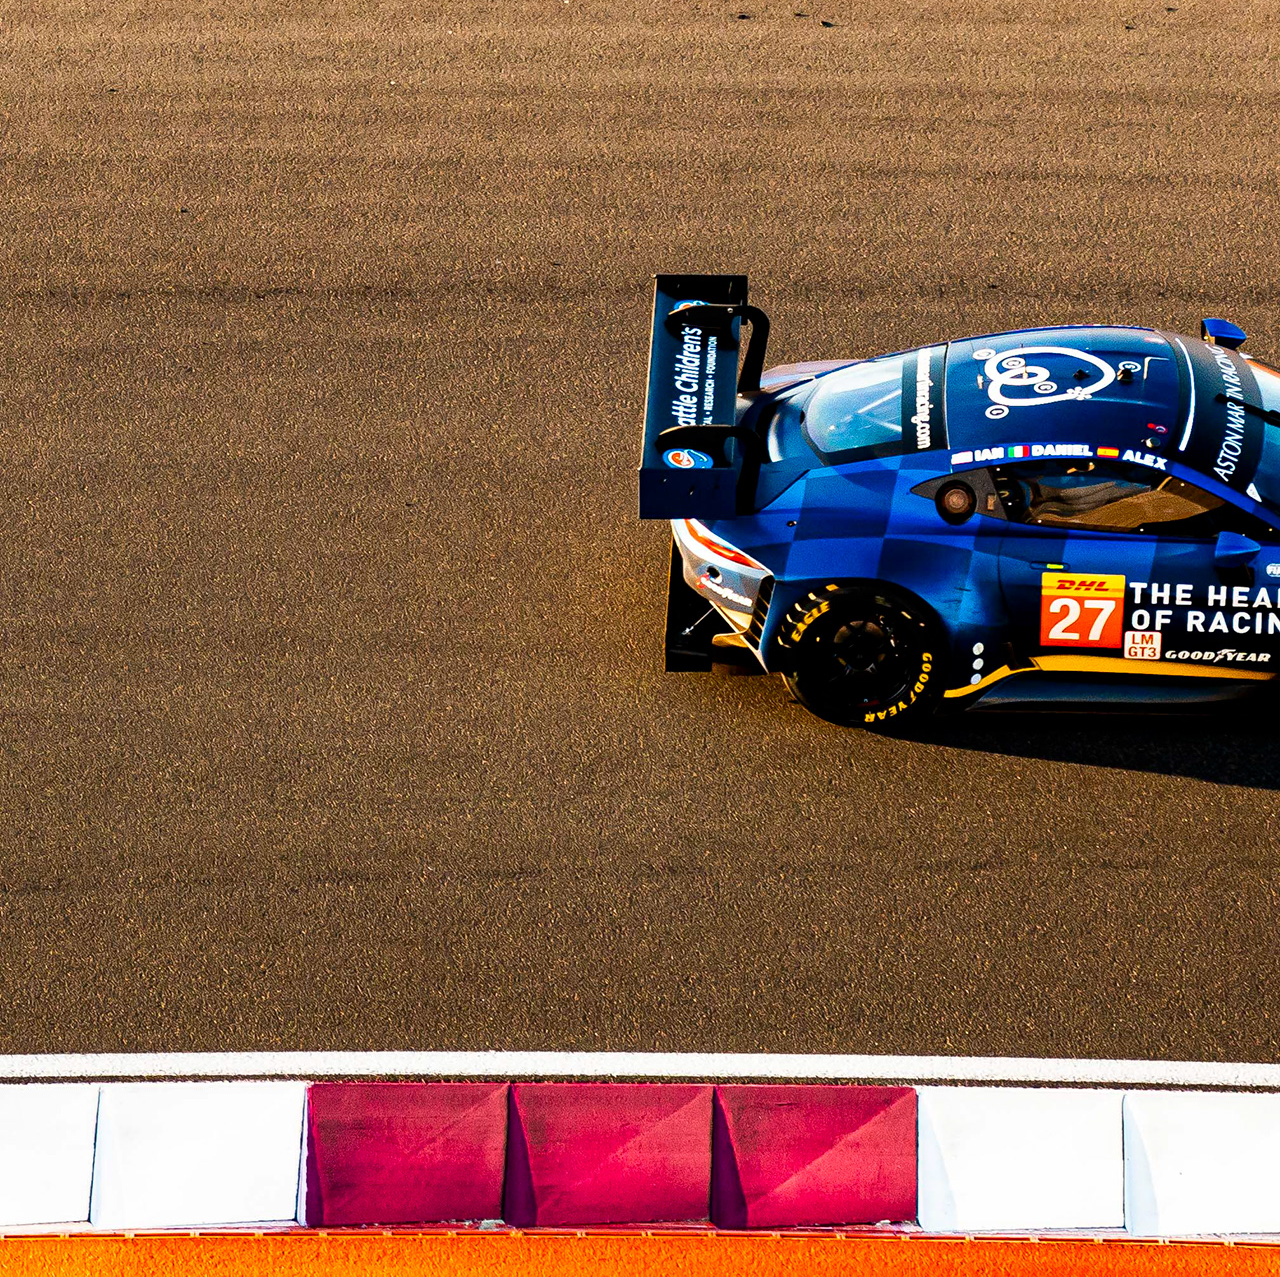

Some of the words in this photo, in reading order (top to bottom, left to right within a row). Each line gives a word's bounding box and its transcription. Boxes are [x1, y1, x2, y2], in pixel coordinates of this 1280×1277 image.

[674, 326, 702, 392] Children's
[705, 336, 718, 374] FOUNDATION
[1205, 343, 1242, 386] RACING
[671, 394, 698, 426] attle
[703, 379, 715, 411] RESEARCH
[1226, 383, 1246, 433] MARIN
[974, 446, 1005, 462] IAN
[1031, 444, 1093, 457] DANIEL
[1122, 449, 1168, 471] ALEX
[1213, 431, 1245, 482] ASTON
[1055, 579, 1110, 592] DHL
[1129, 581, 1194, 606] THE
[1048, 598, 1116, 641] 27
[1131, 609, 1173, 631] OF
[1128, 646, 1157, 658] GT3
[1131, 633, 1154, 645] LM
[1164, 648, 1271, 663] GOODYEAR
[864, 652, 933, 723] GOODYEAR
